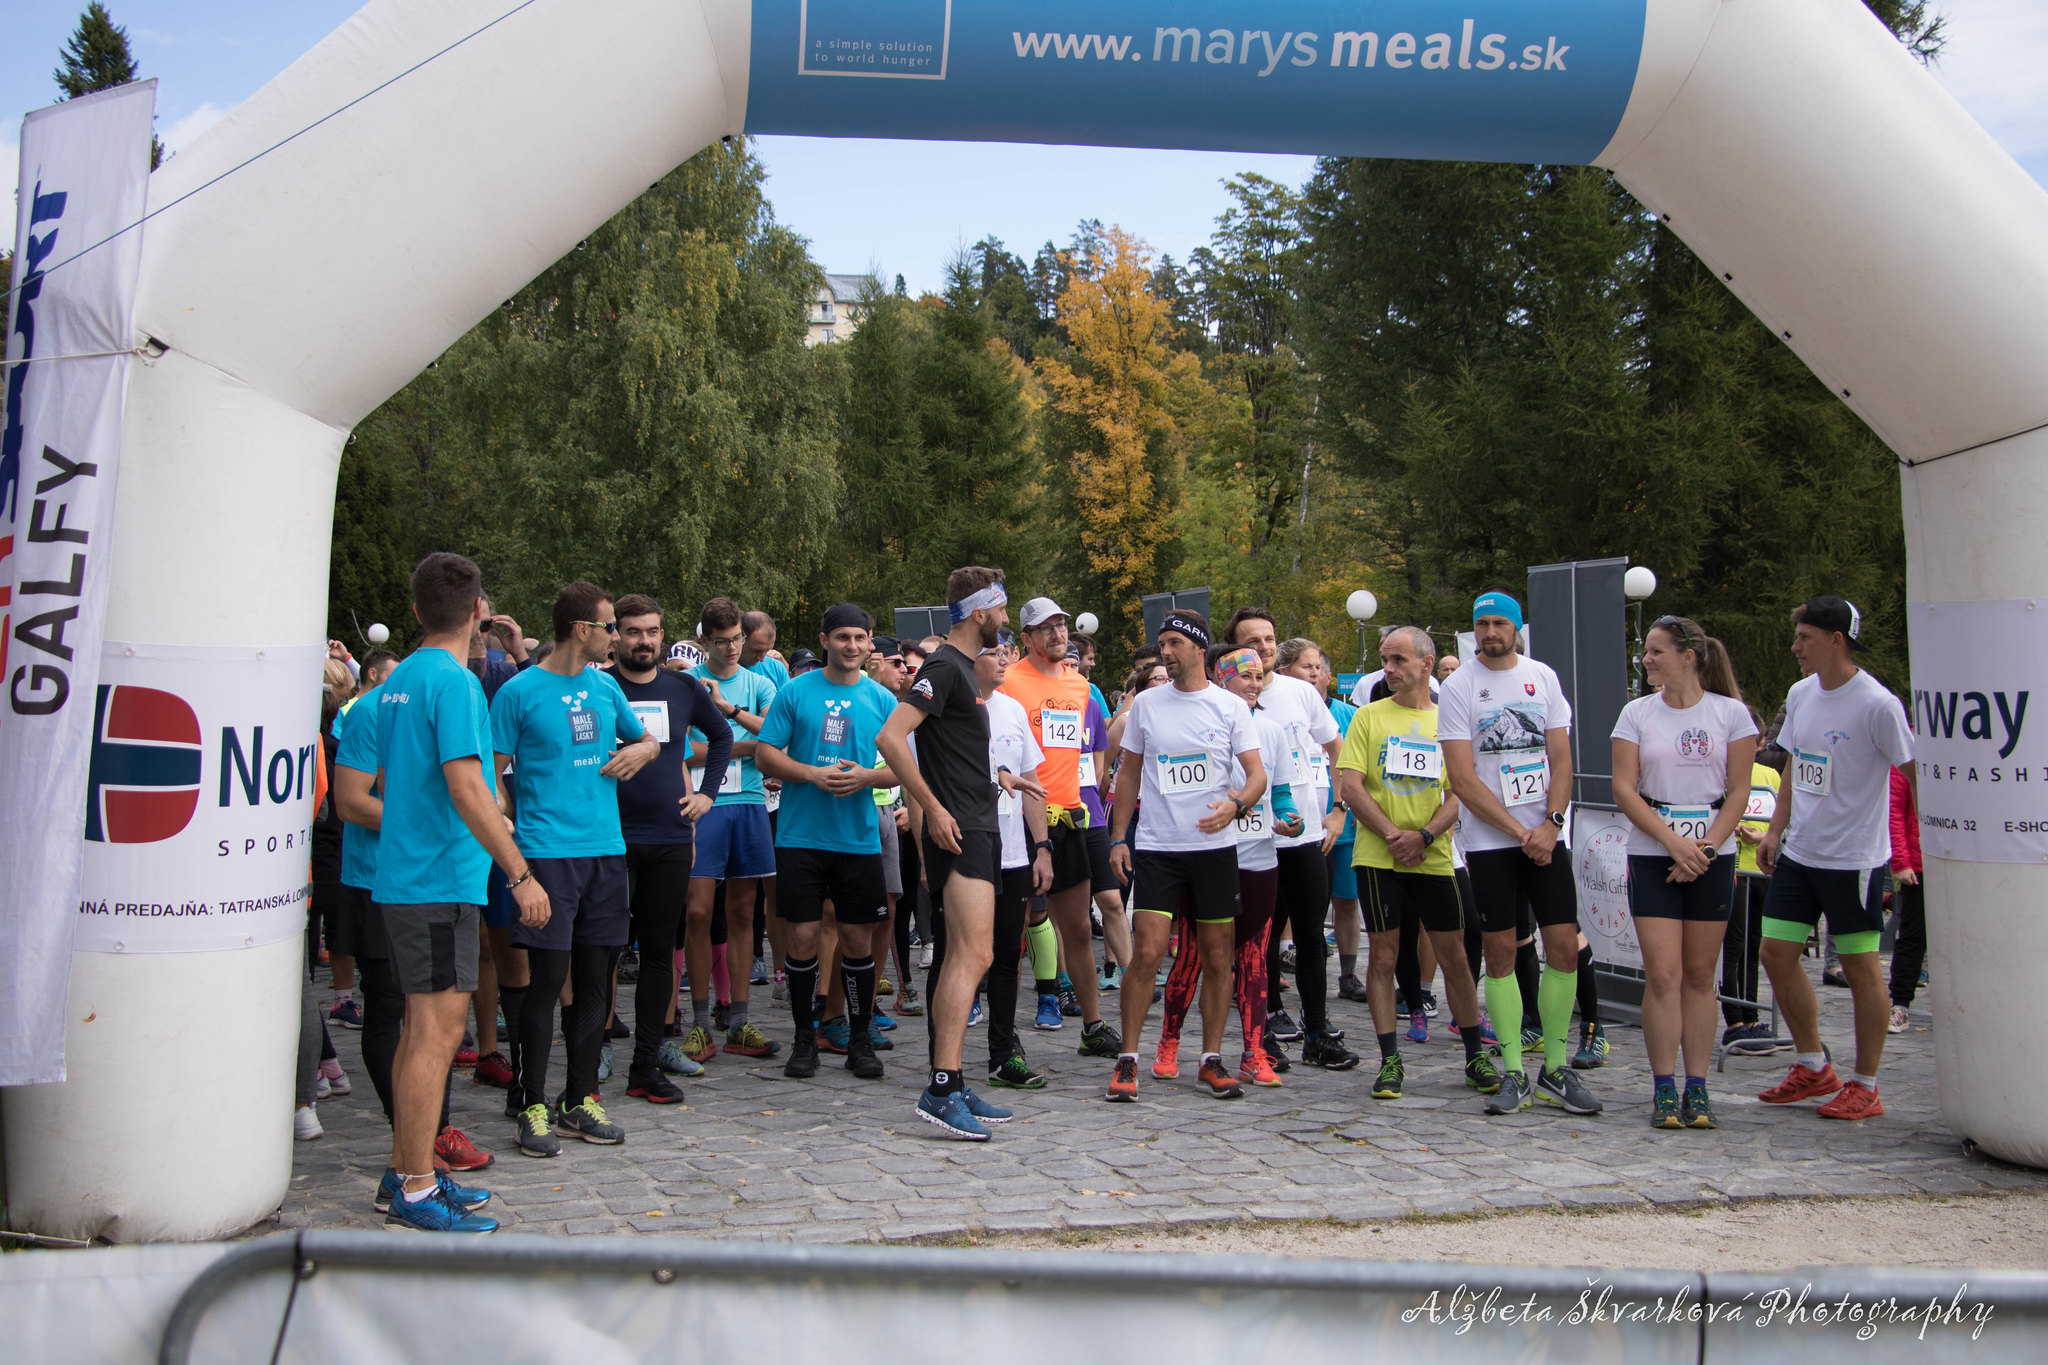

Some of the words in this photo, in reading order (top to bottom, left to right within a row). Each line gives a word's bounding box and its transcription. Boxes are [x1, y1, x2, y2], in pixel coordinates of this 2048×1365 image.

[815, 40, 822, 48] a
[829, 39, 872, 51] simple
[879, 41, 933, 53] solution
[815, 53, 828, 62] to
[837, 54, 875, 64] world
[883, 55, 930, 67] hunger
[10, 444, 98, 716] GALFY
[1172, 619, 1209, 647] GARM
[1049, 723, 1076, 741] 142
[1402, 751, 1426, 771] 18
[1168, 763, 1206, 785] 100
[1511, 772, 1545, 796] 121
[1798, 762, 1823, 786] 108
[1963, 819, 1977, 832] 32
[1582, 870, 1608, 893] Walsh
[219, 890, 291, 915] TATRANSKÁ
